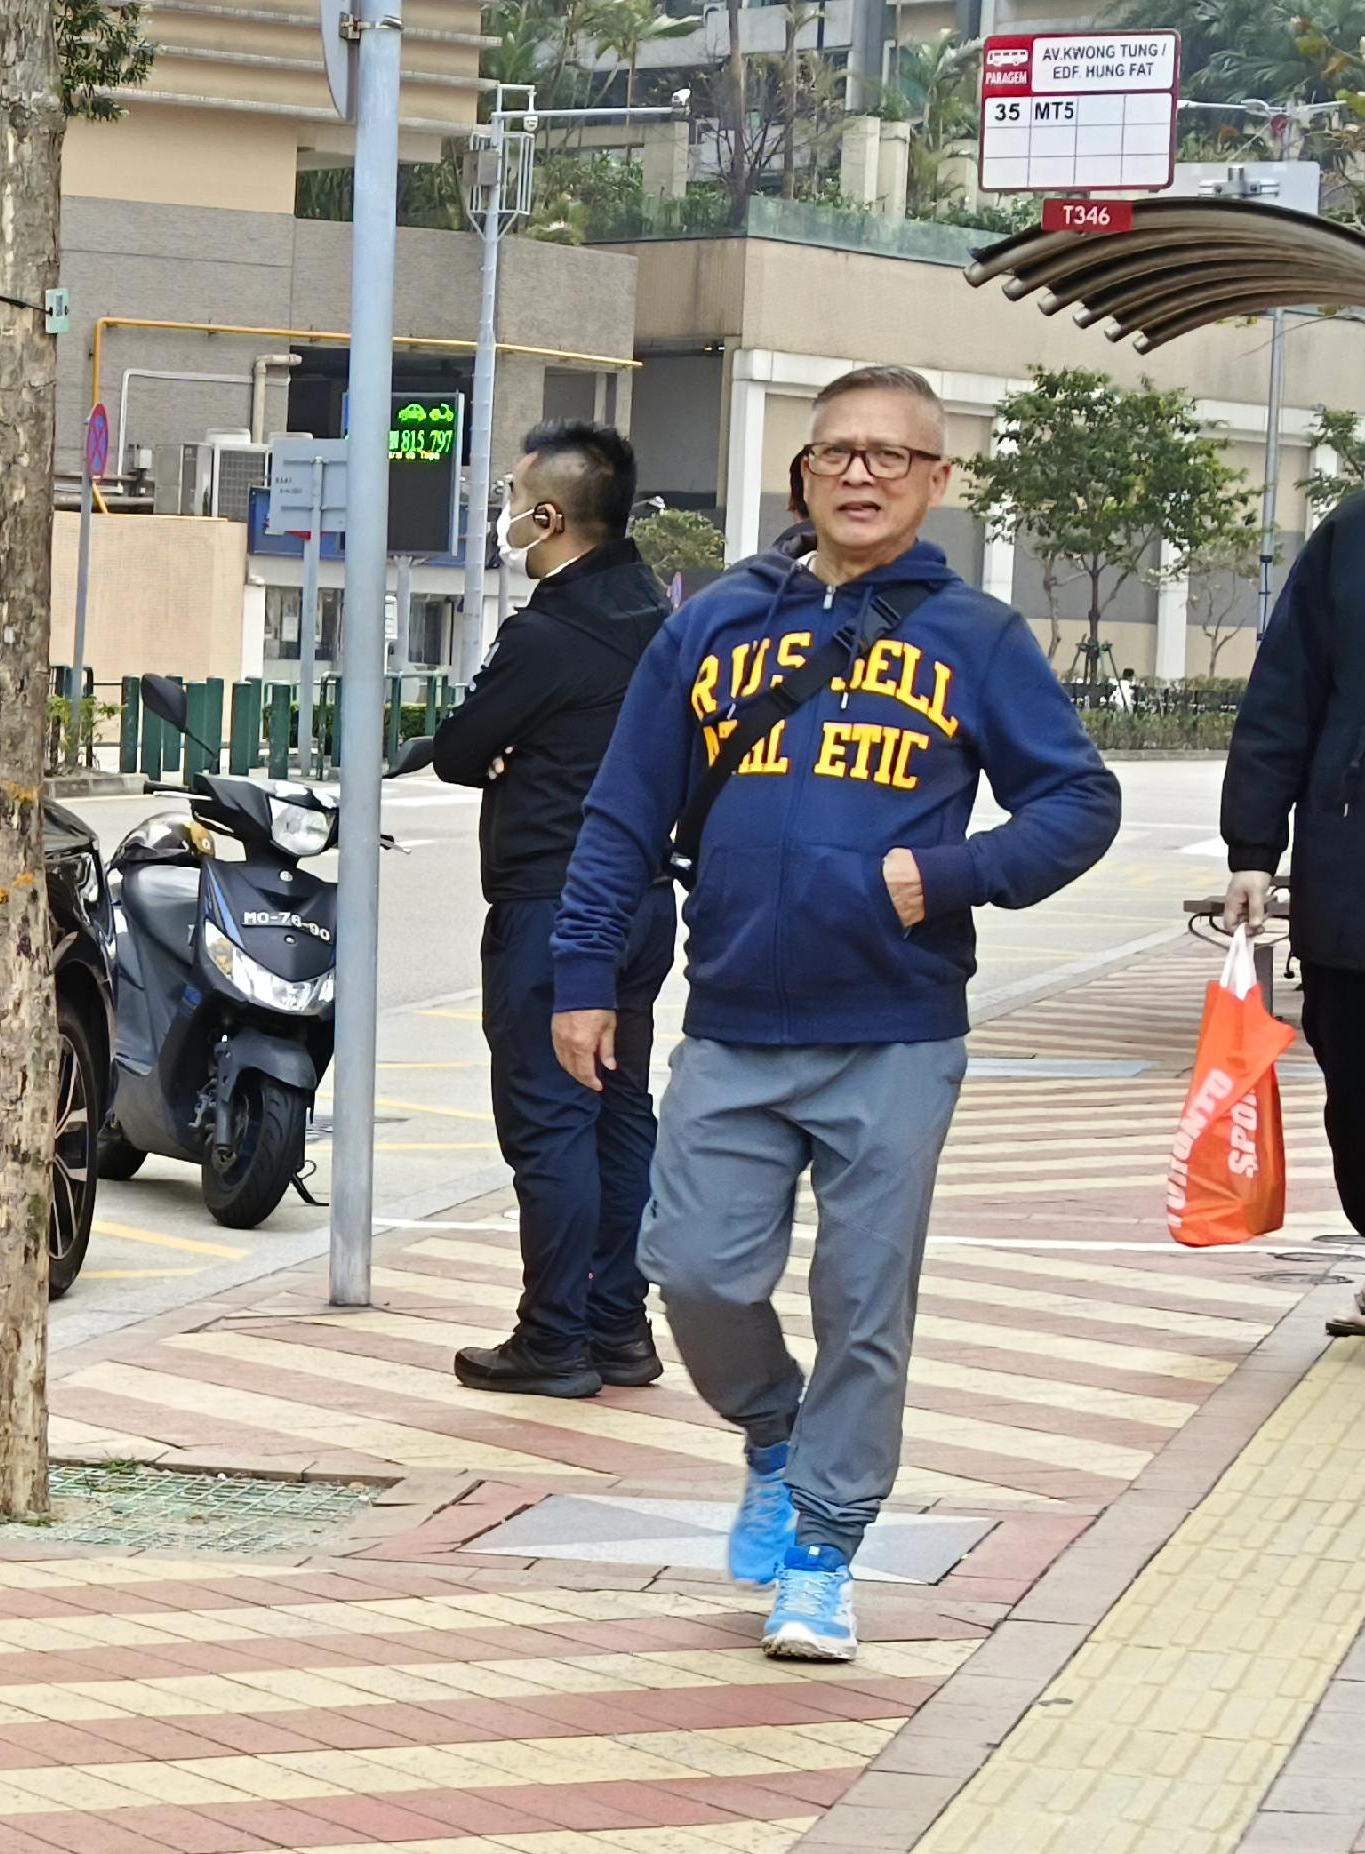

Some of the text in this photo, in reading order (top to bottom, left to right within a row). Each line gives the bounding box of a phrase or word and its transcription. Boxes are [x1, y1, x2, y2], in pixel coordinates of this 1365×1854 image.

[1121, 42, 1159, 58] TUNG
[1085, 65, 1125, 78] HUNG
[1129, 62, 1154, 77] FAT
[994, 102, 1020, 121] 35
[1035, 101, 1074, 120] MT5
[1063, 205, 1111, 226] T346
[702, 718, 930, 790] LETIC
